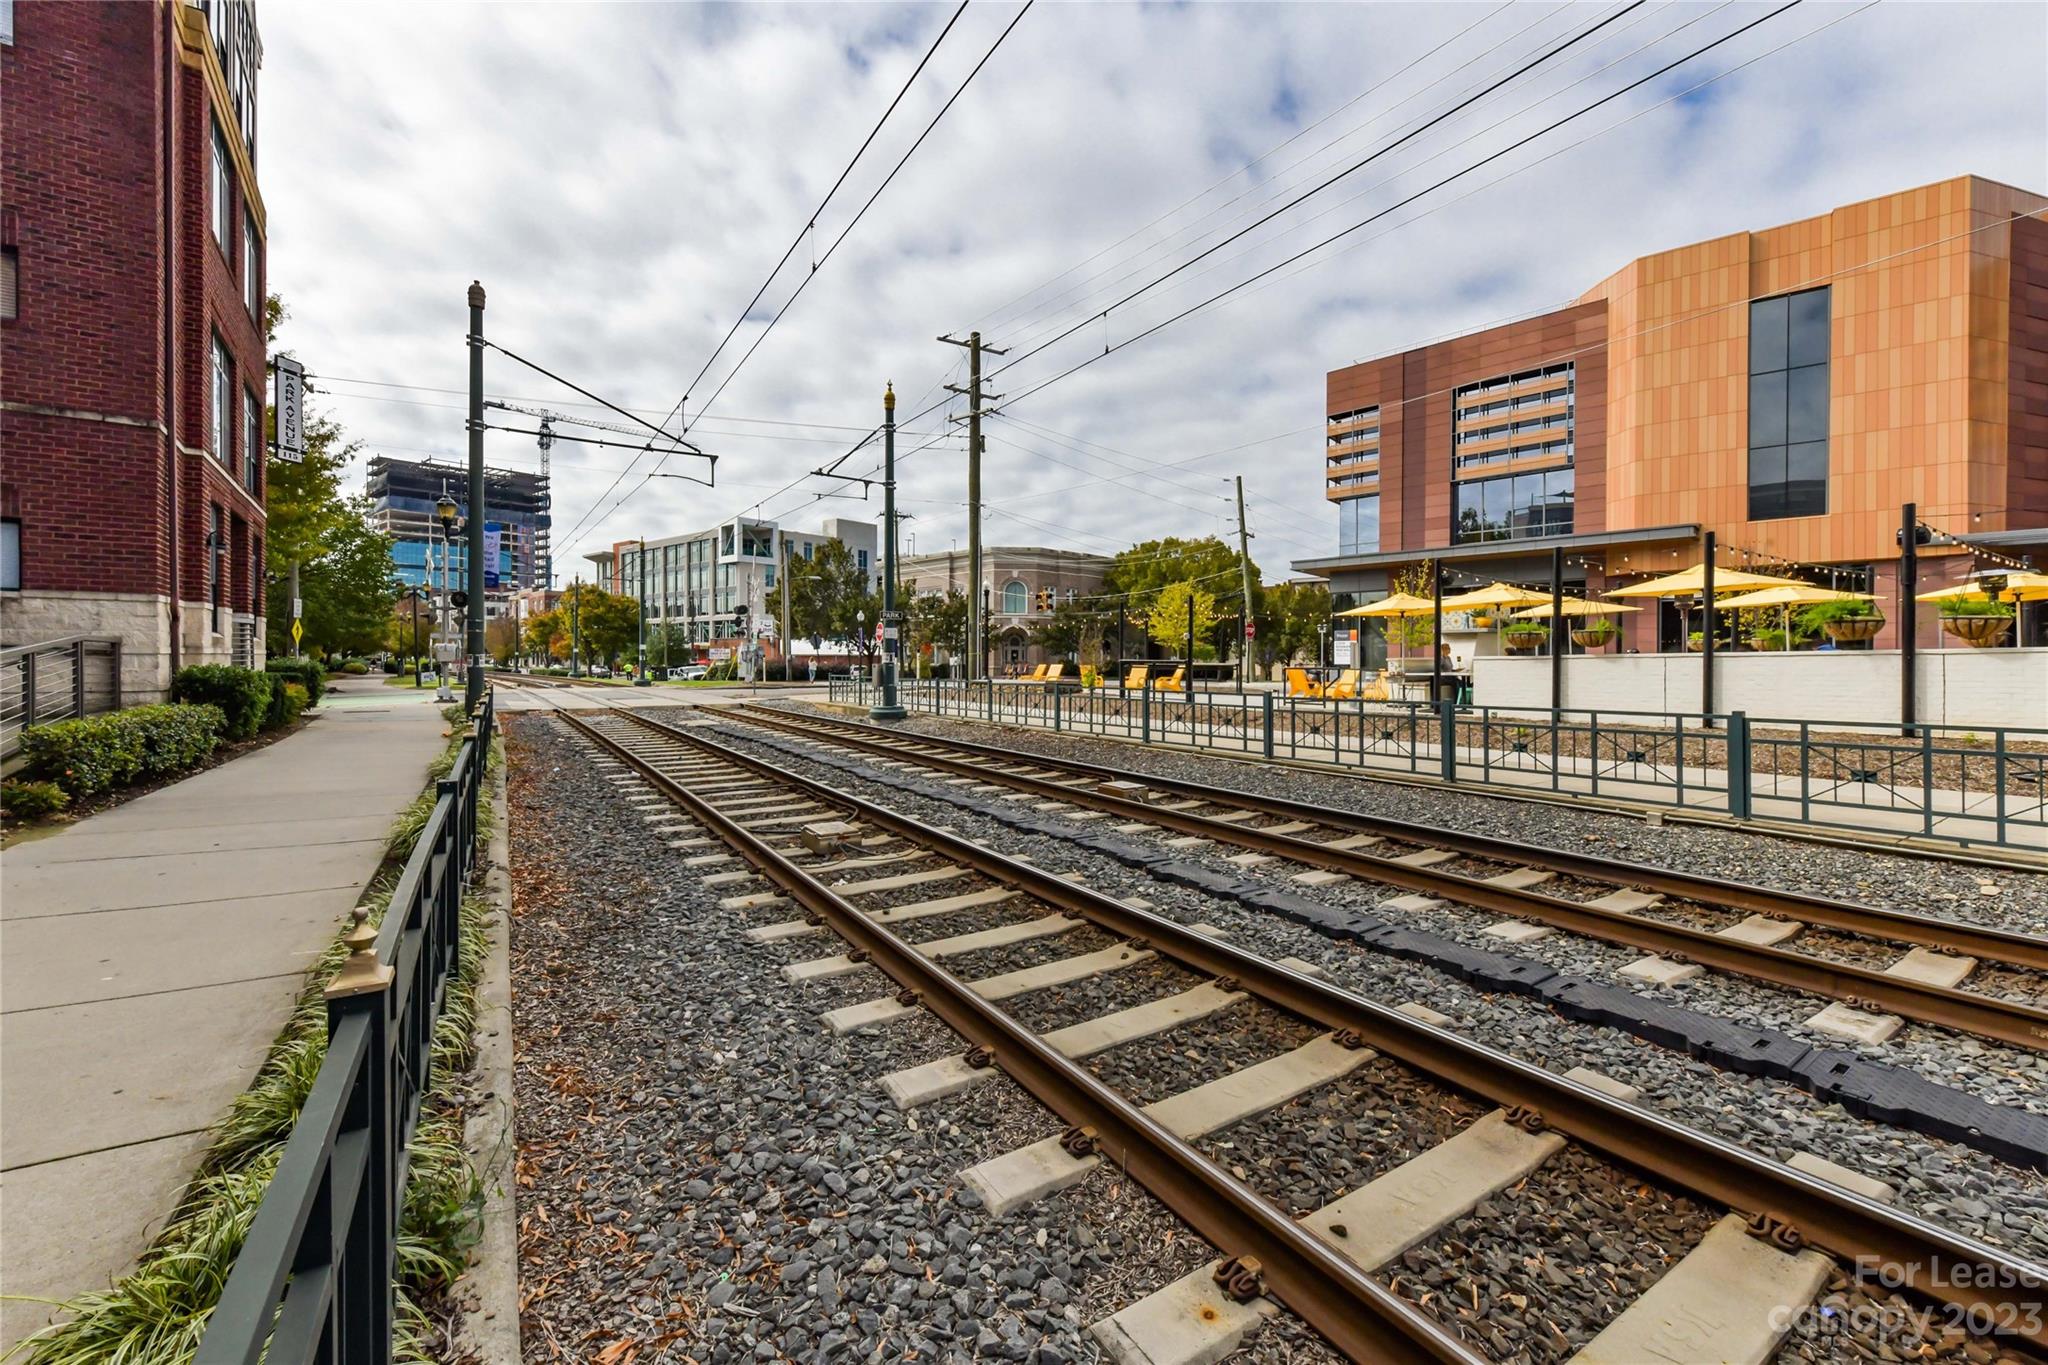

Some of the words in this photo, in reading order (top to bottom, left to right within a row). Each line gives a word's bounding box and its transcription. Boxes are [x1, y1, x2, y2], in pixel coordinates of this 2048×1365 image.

[285, 375, 295, 404] PARK
[285, 405, 295, 446] AVENUE
[282, 451, 299, 460] 115
